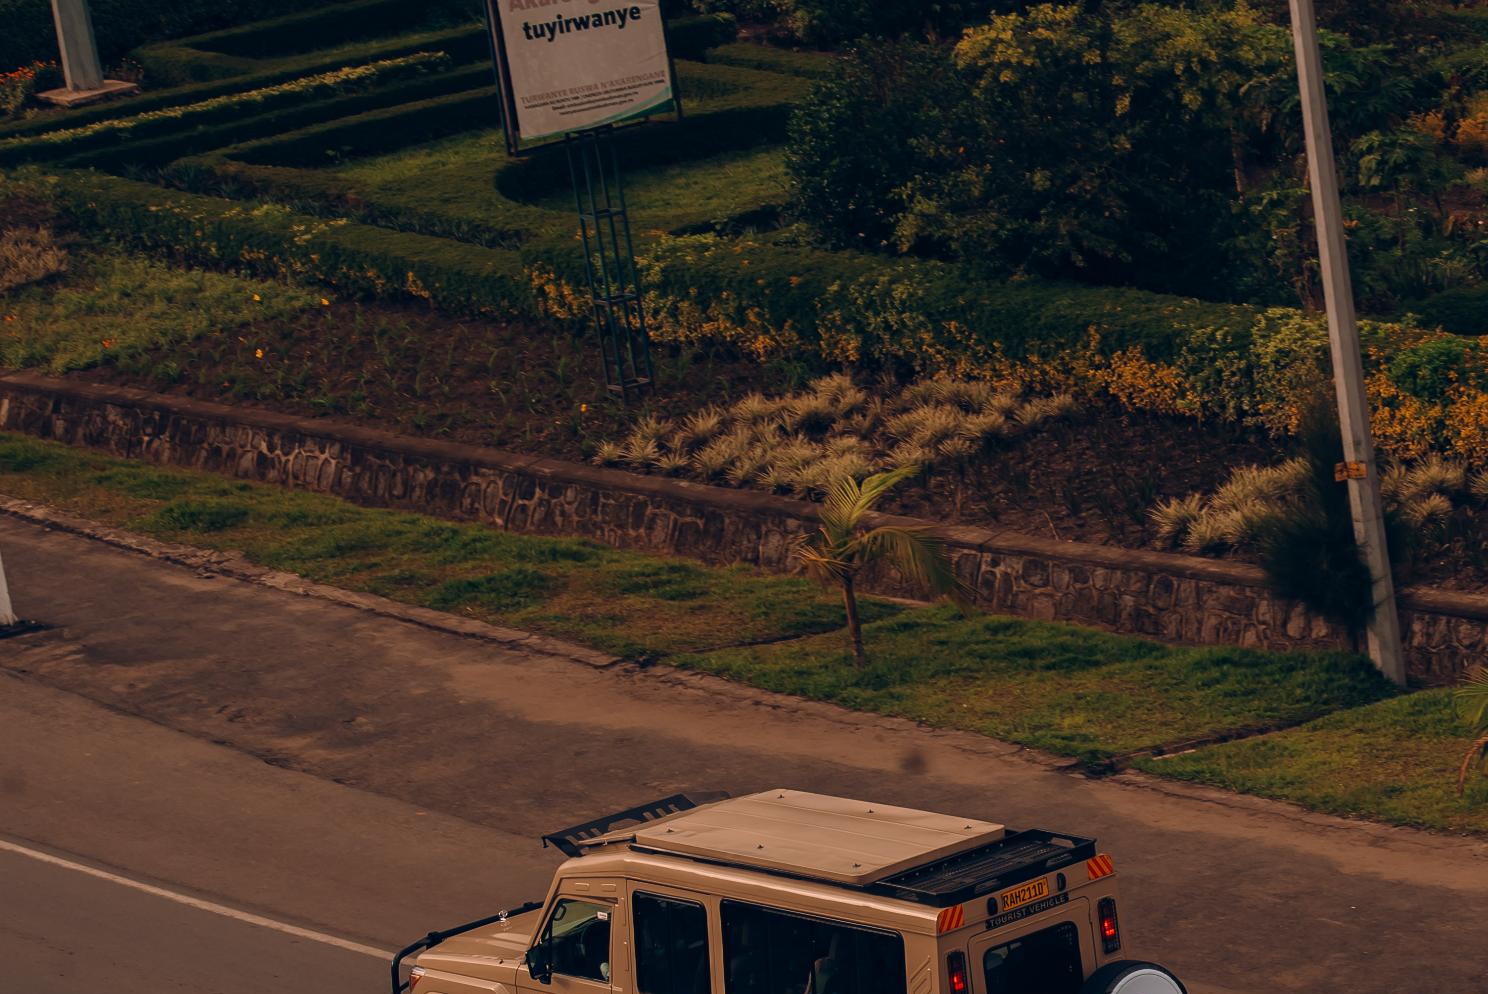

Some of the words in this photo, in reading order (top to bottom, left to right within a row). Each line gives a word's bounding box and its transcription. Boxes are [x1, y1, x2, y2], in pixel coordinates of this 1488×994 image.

[523, 6, 641, 42] tuyirwanye
[990, 909, 1027, 927] TOURIST
[1030, 894, 1066, 914] VEHICLE
